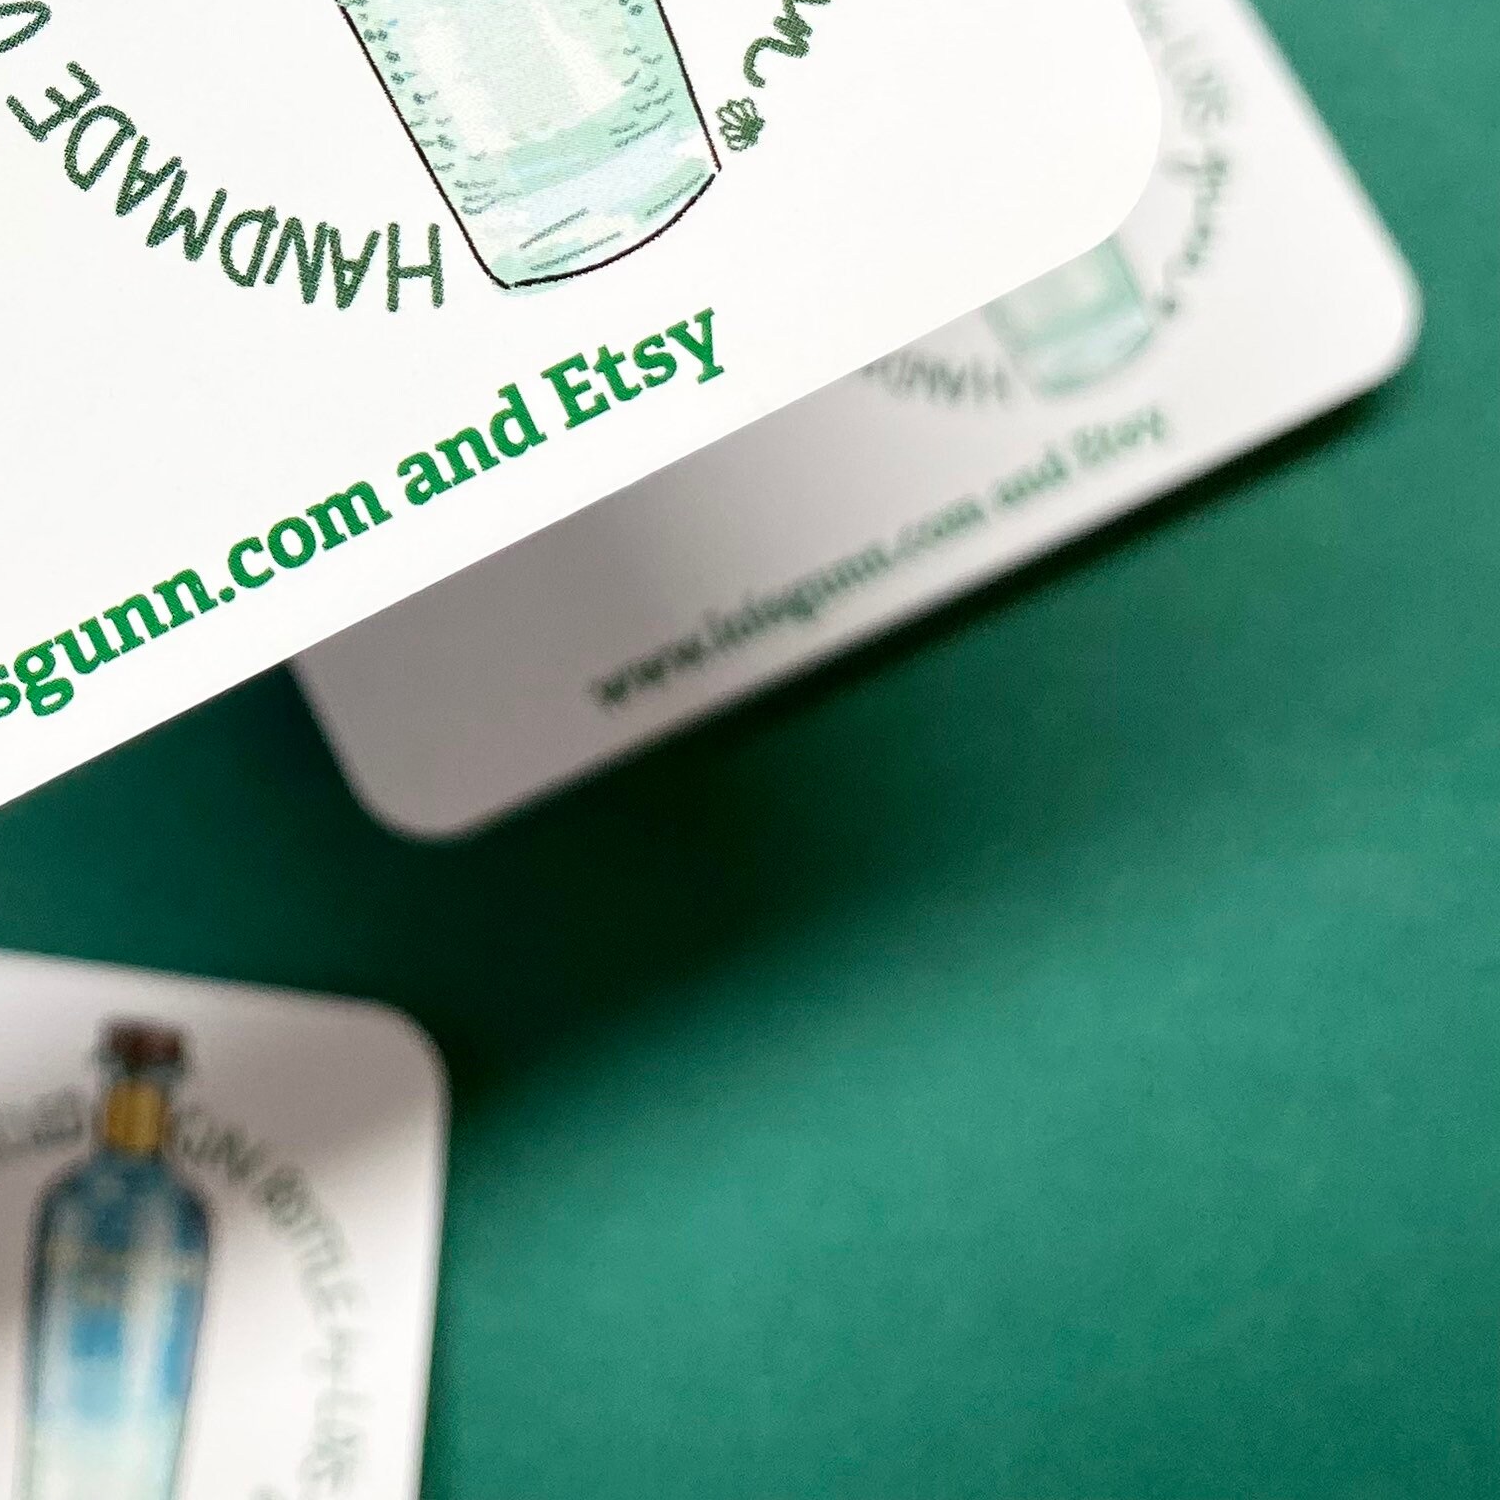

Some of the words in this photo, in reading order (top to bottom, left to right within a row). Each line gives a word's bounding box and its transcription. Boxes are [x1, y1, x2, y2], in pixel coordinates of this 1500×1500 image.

[5, 61, 446, 313] HANDMADE
[398, 384, 547, 505] and
[541, 307, 725, 429] Etsy
